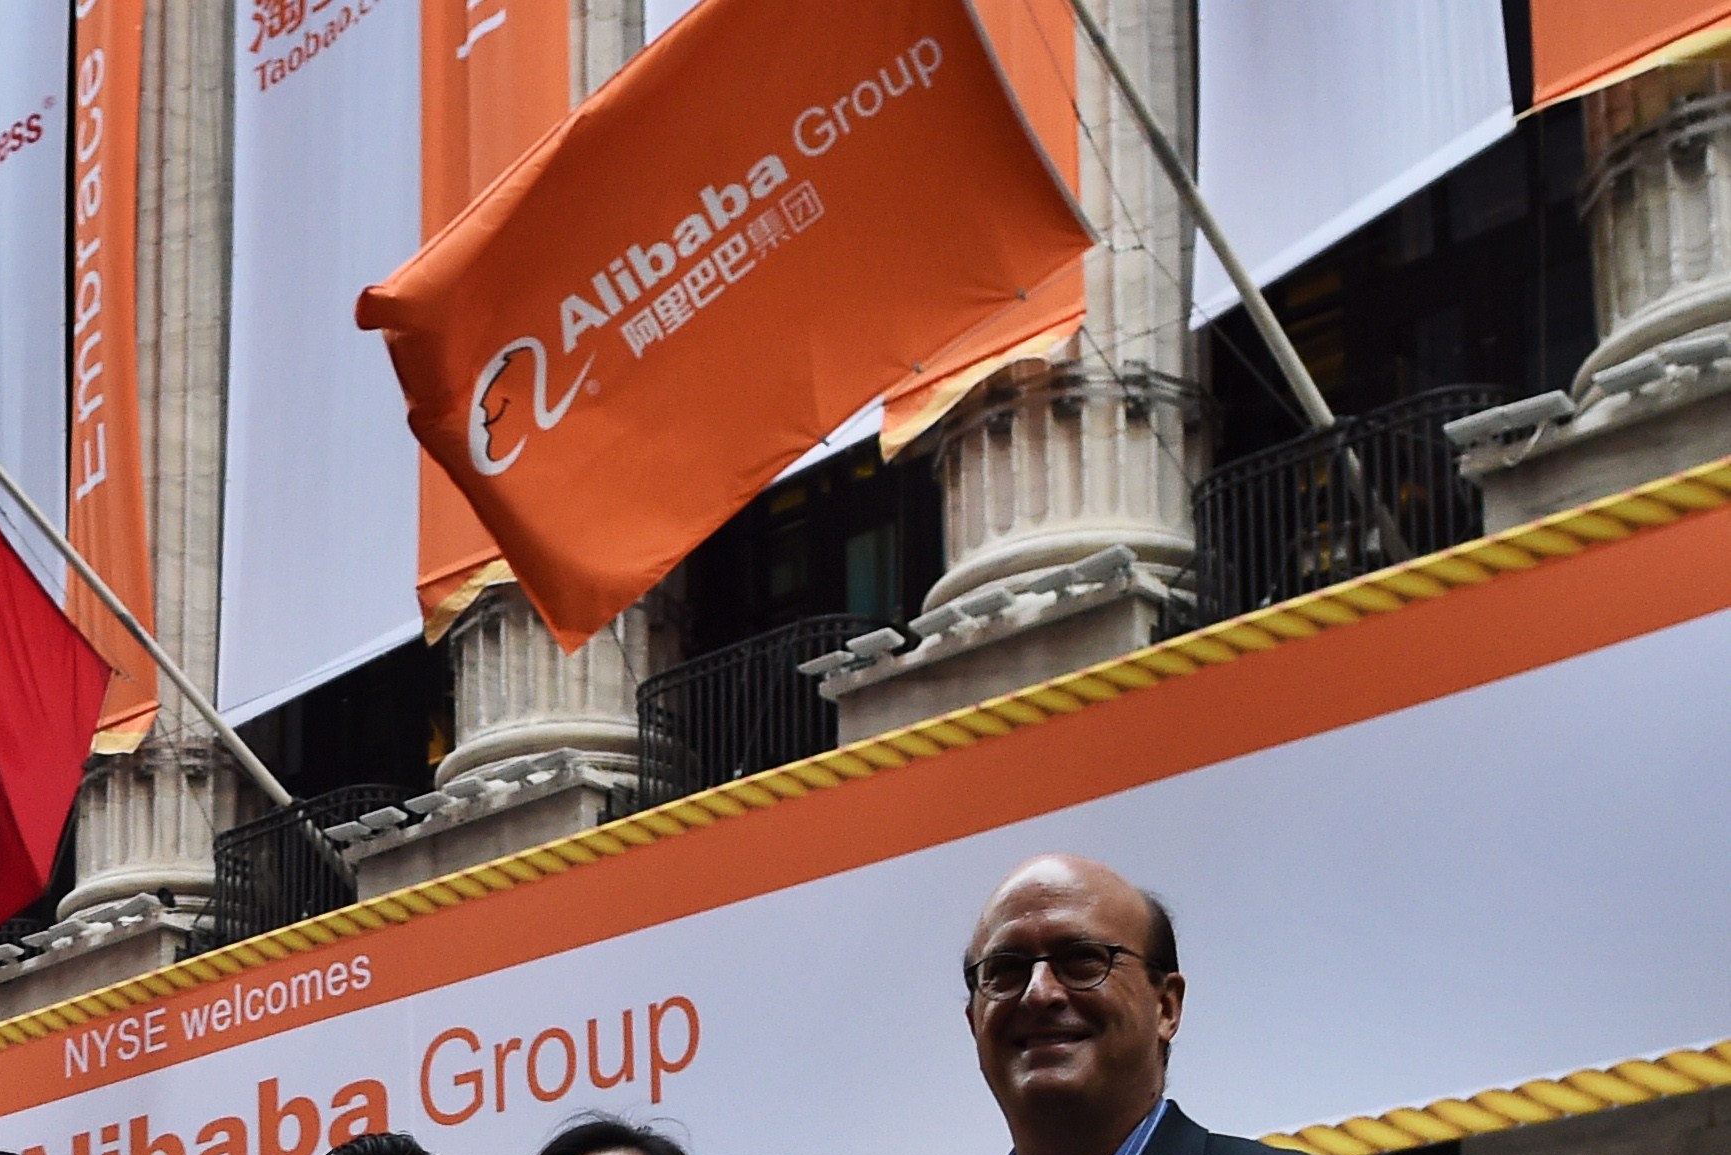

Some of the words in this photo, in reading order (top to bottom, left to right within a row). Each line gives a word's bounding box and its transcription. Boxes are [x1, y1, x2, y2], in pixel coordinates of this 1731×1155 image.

[75, 47, 107, 501] Embrace
[557, 154, 790, 354] Alibaba
[792, 37, 944, 157] Group
[64, 1007, 168, 1078] NYSE
[180, 954, 373, 1041] welcomes
[420, 995, 701, 1126] Group
